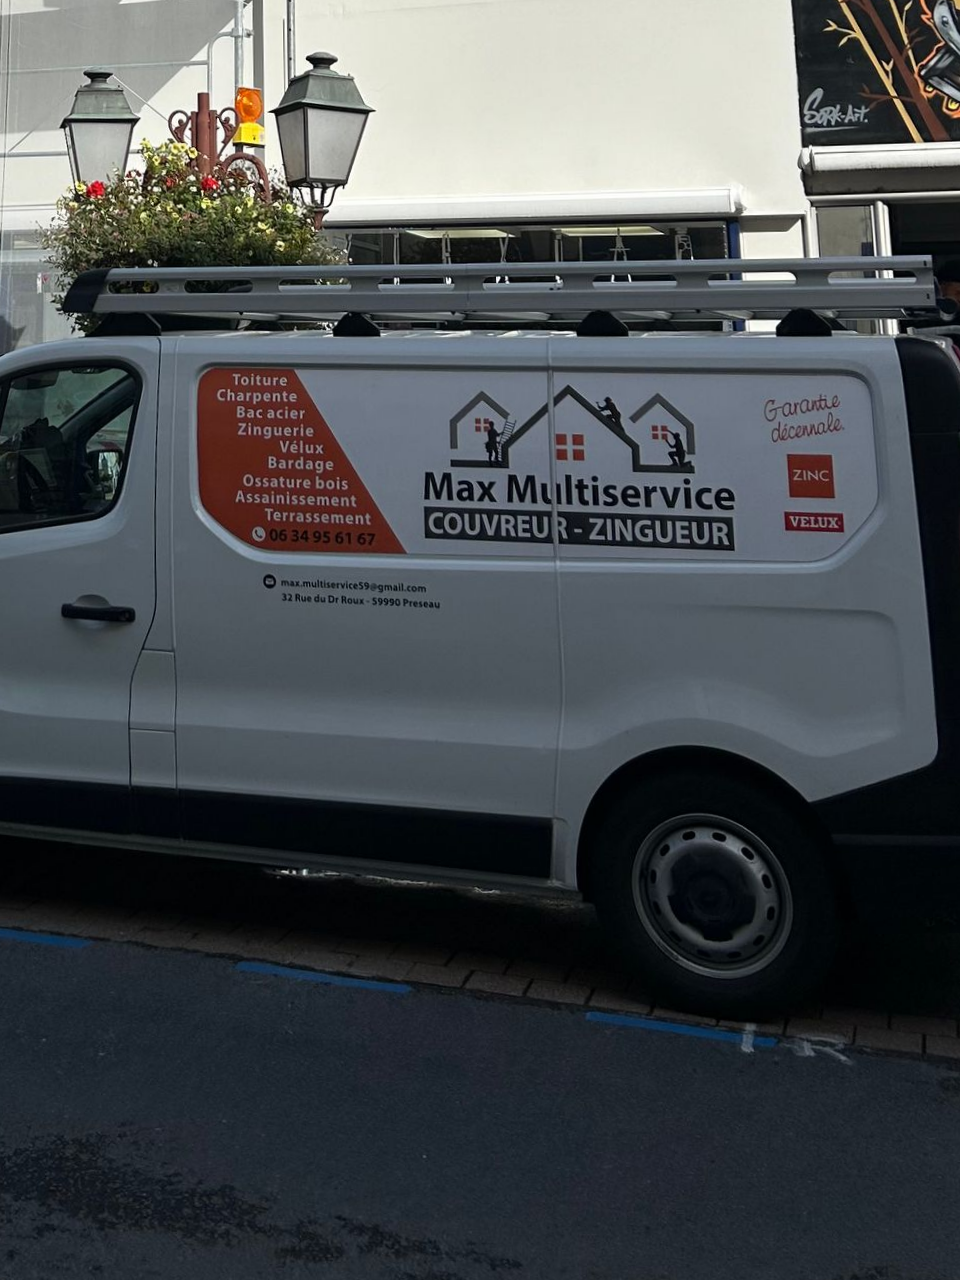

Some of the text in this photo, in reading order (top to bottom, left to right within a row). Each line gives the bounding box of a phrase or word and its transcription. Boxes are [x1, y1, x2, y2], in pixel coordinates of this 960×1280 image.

[233, 373, 288, 386] Toiture
[217, 389, 297, 404] Charpente
[237, 406, 305, 420] Bac acier
[763, 394, 841, 422] Garantie
[238, 423, 314, 438] Zinguerie
[280, 441, 323, 454] Vélux
[268, 457, 334, 473] Bardage
[243, 474, 348, 490] Ossature bois
[793, 469, 829, 482] ZINC
[236, 491, 356, 507] Assainissement
[424, 472, 735, 510] Max Multiservice
[265, 509, 371, 525] Terrassement
[789, 516, 839, 530] VELUX
[270, 528, 375, 545] 06 34 95 61 67
[428, 512, 567, 540] COUVREUR
[589, 518, 731, 546] ZINGUEUR
[281, 578, 426, 593] max.multiservice59@gmail.com
[282, 593, 293, 602] 32
[295, 594, 312, 602] Rue
[314, 594, 326, 603] du
[328, 596, 339, 604] Dr
[341, 596, 364, 604] Roux
[372, 598, 400, 606] 59990
[403, 599, 440, 609] Preseau
